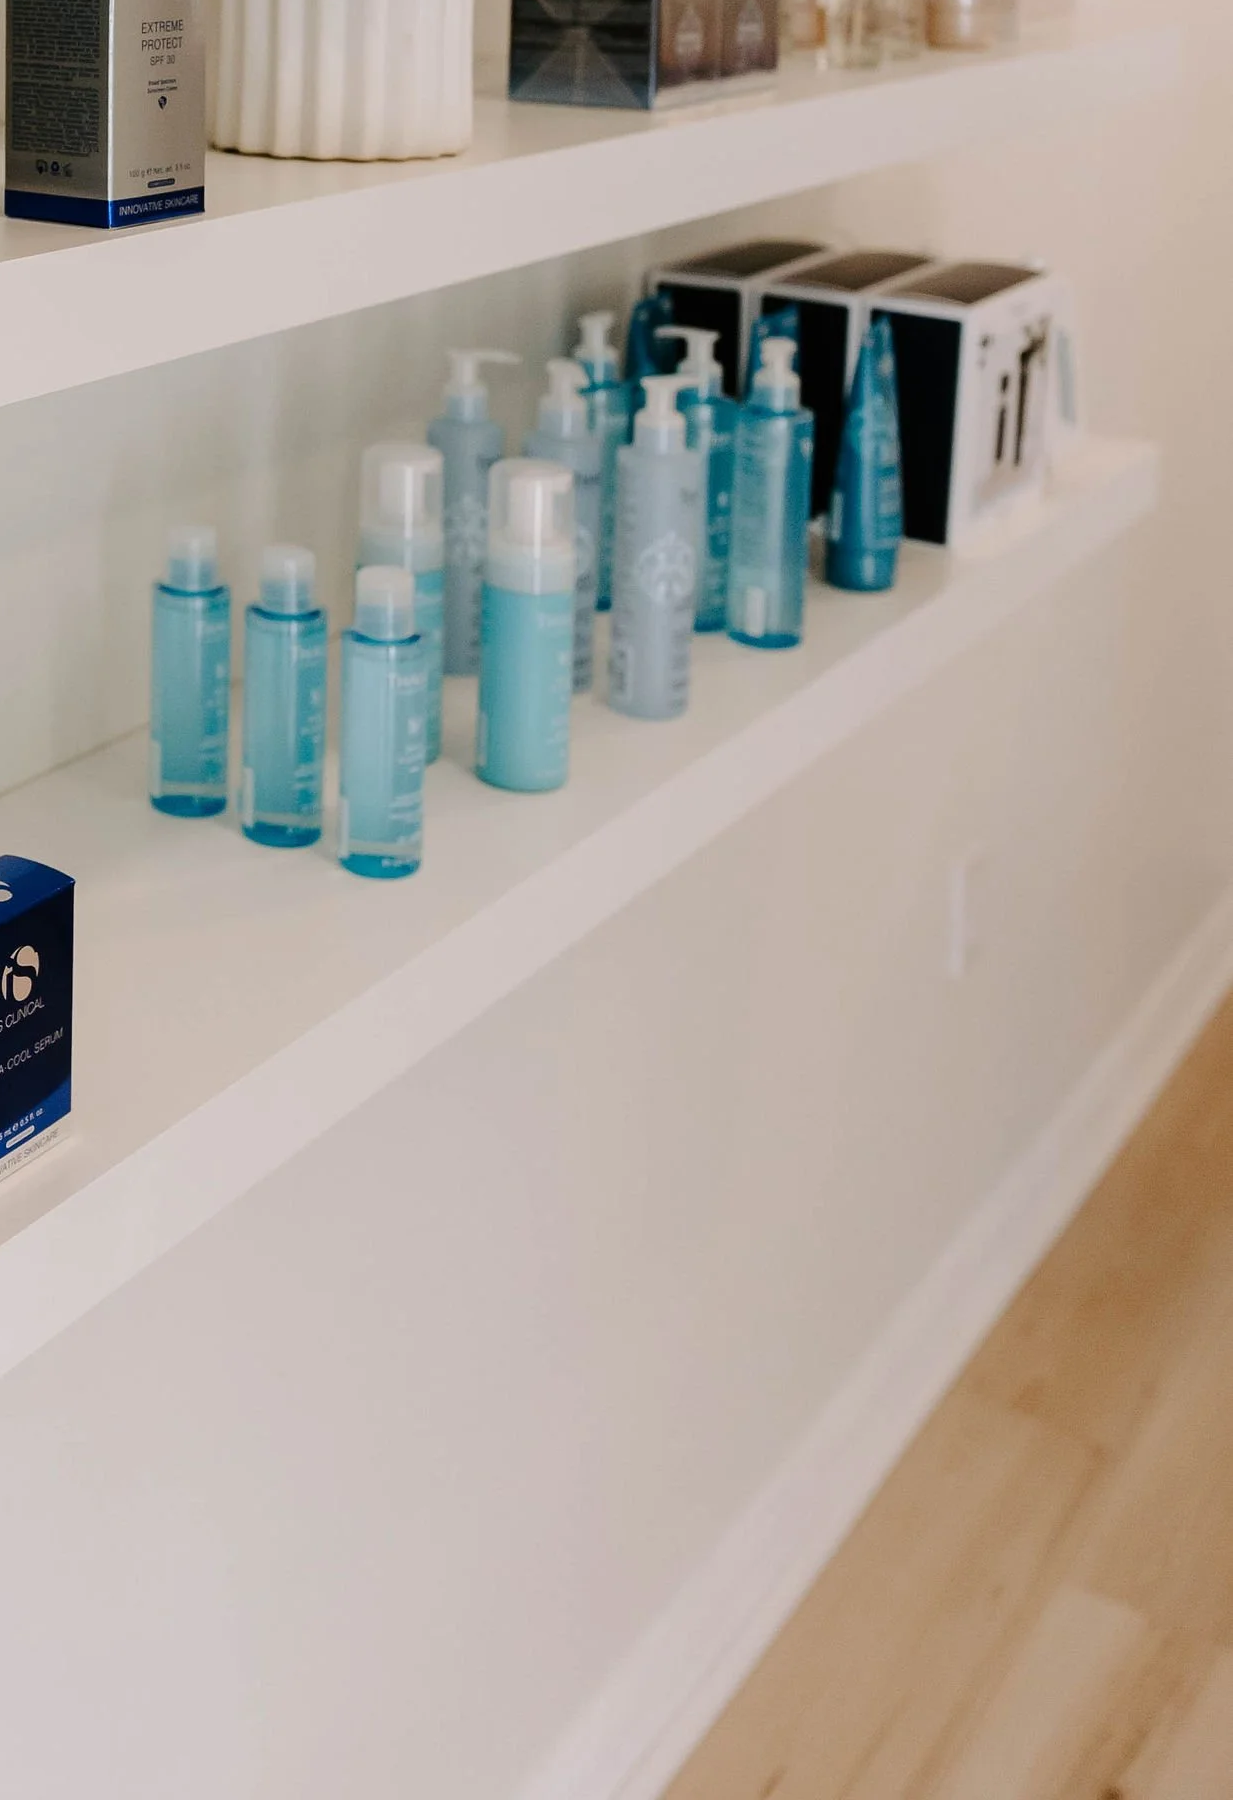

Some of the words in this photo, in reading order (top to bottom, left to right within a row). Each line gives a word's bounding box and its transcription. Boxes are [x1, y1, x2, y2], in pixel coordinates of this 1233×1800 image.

[141, 19, 184, 34] EXTREME
[141, 36, 183, 52] PROTECT
[149, 55, 165, 66] SPF
[166, 54, 176, 65] 30
[119, 199, 164, 217] INNOVATIVE
[164, 193, 199, 210] SKINCARE
[5, 996, 46, 1029] CLINICAL
[33, 1026, 65, 1055] SERUM
[19, 1115, 29, 1127] 0.5
